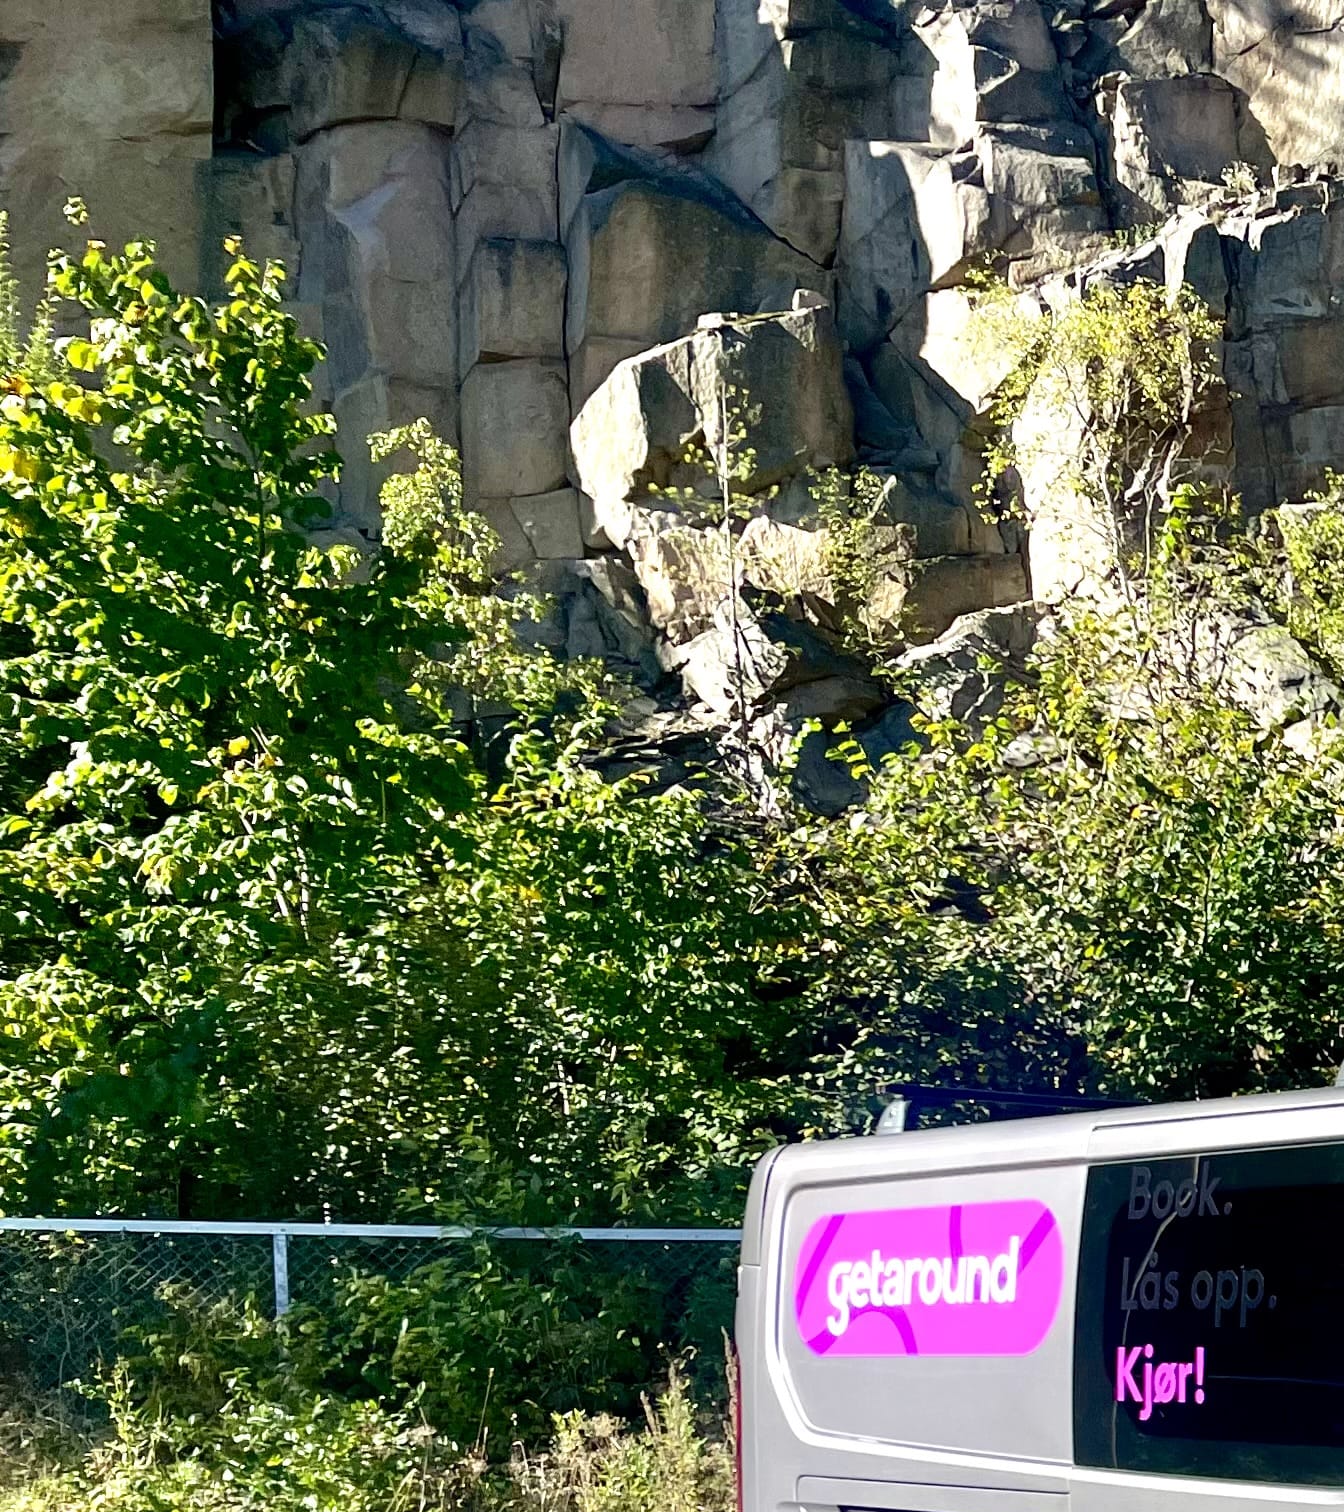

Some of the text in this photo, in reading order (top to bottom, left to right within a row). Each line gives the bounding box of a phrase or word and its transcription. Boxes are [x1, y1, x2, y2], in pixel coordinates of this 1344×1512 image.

[1128, 1160, 1233, 1219] Book.
[828, 1235, 1019, 1336] getaround
[1120, 1252, 1277, 1328] Lås opp.
[1115, 1344, 1206, 1420] Kjør!
